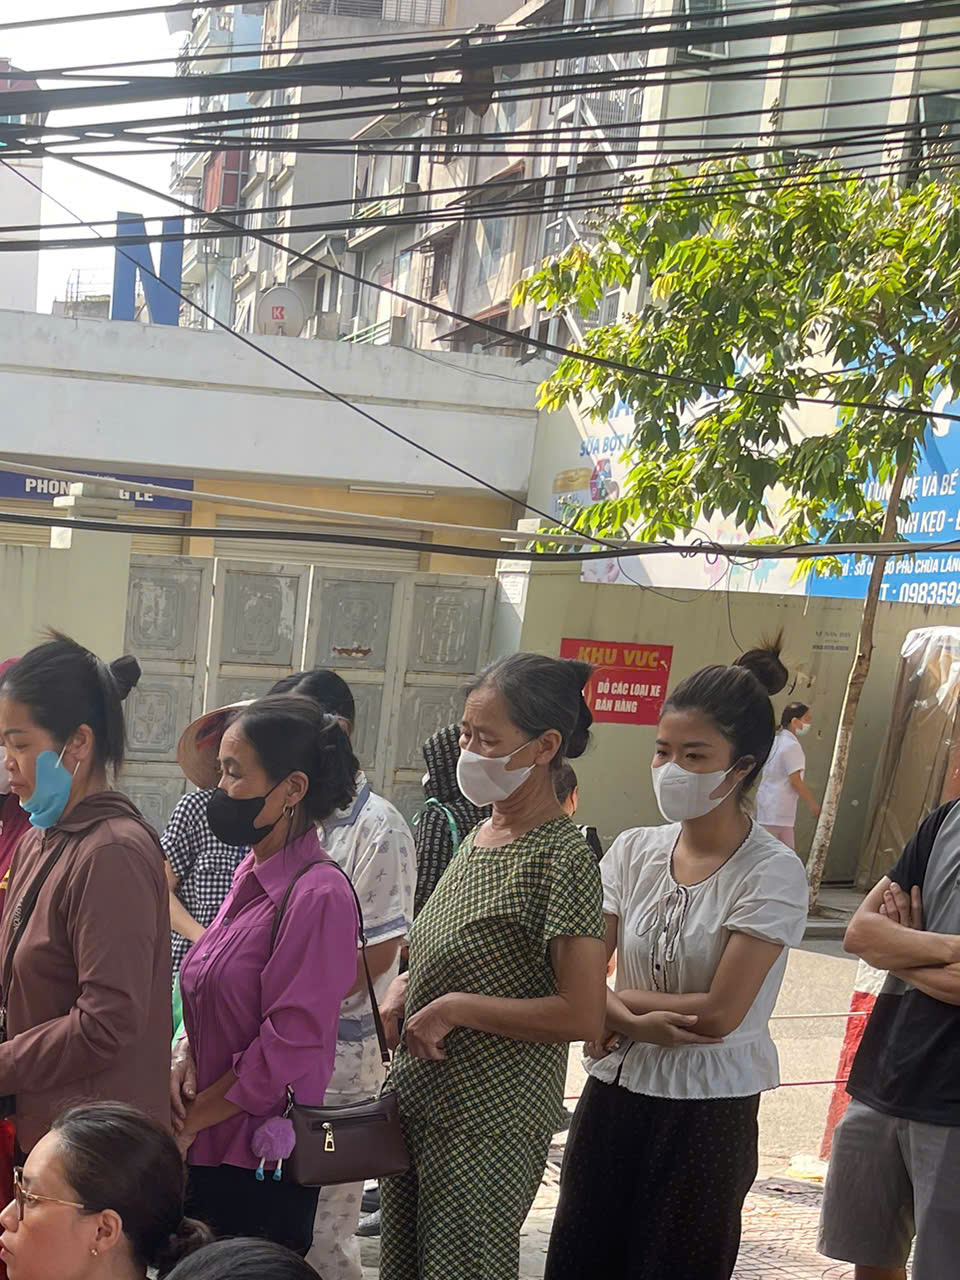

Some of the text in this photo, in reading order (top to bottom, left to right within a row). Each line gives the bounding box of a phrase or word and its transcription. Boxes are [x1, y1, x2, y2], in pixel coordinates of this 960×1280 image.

[922, 471, 937, 497] VÀ
[940, 468, 959, 495] BÉ
[920, 510, 946, 536] KẸO
[914, 557, 939, 574] CHÙA
[940, 555, 960, 573] LÁN
[577, 647, 617, 665] KHU
[611, 680, 629, 695] CÁC
[650, 685, 661, 697] XE
[595, 697, 638, 713] BÁN HÀNG
